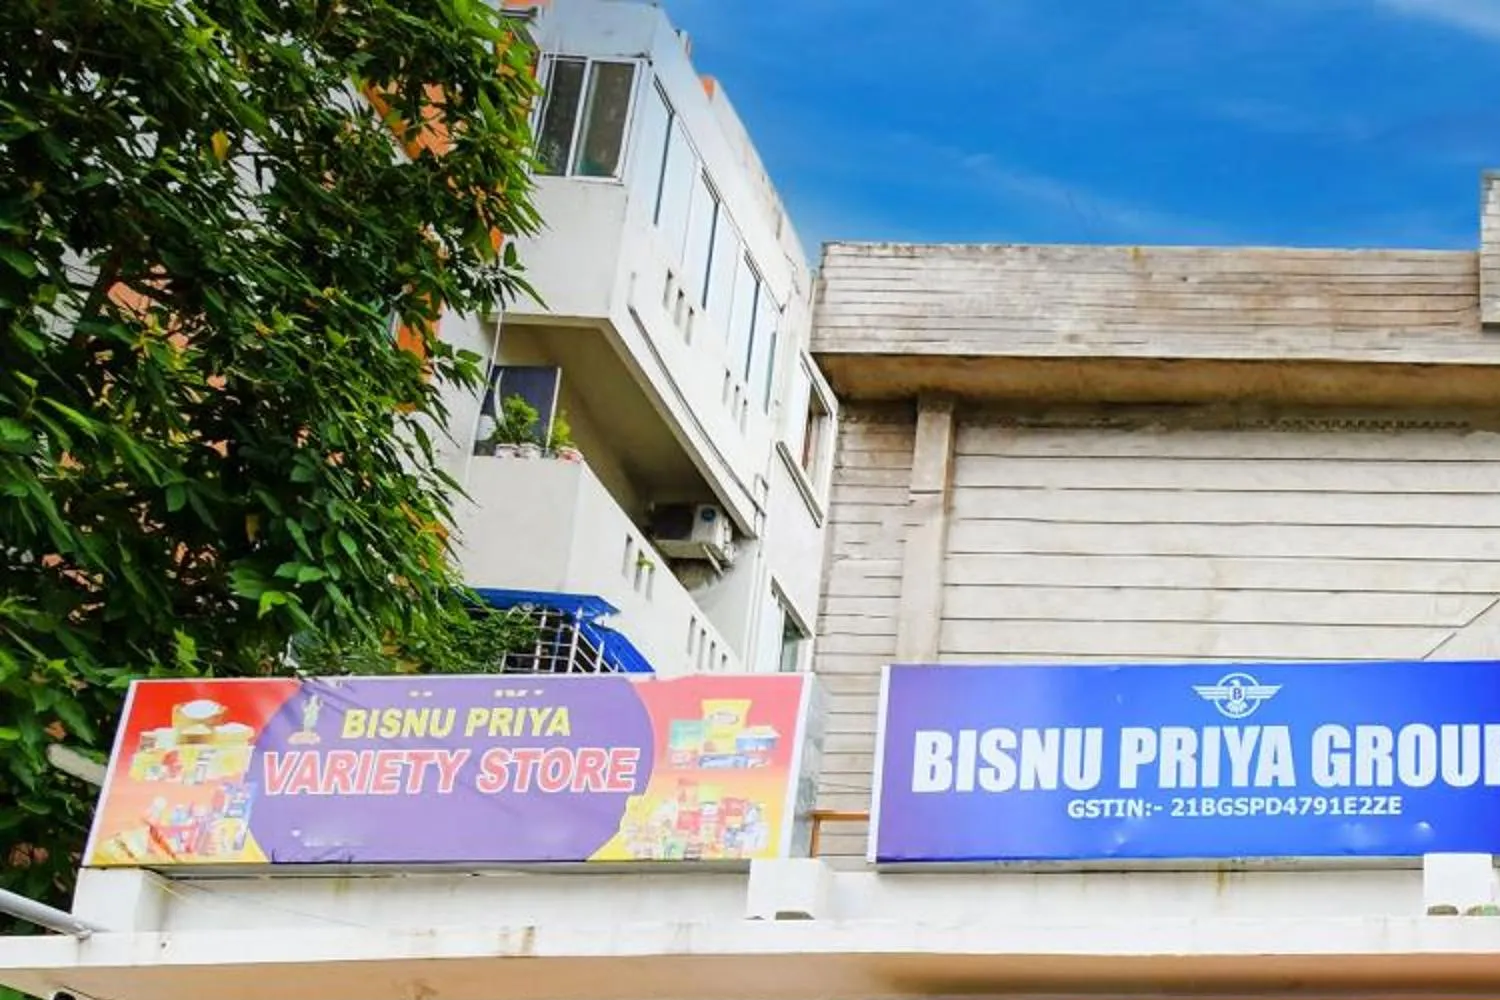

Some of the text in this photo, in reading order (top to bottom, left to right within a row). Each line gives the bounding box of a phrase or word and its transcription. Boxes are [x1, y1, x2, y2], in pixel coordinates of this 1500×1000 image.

[342, 707, 571, 739] BISNU PRIYA
[262, 747, 638, 795] VARIETY STORE
[911, 728, 1103, 793] BISNU
[1119, 724, 1298, 790] PRIYA
